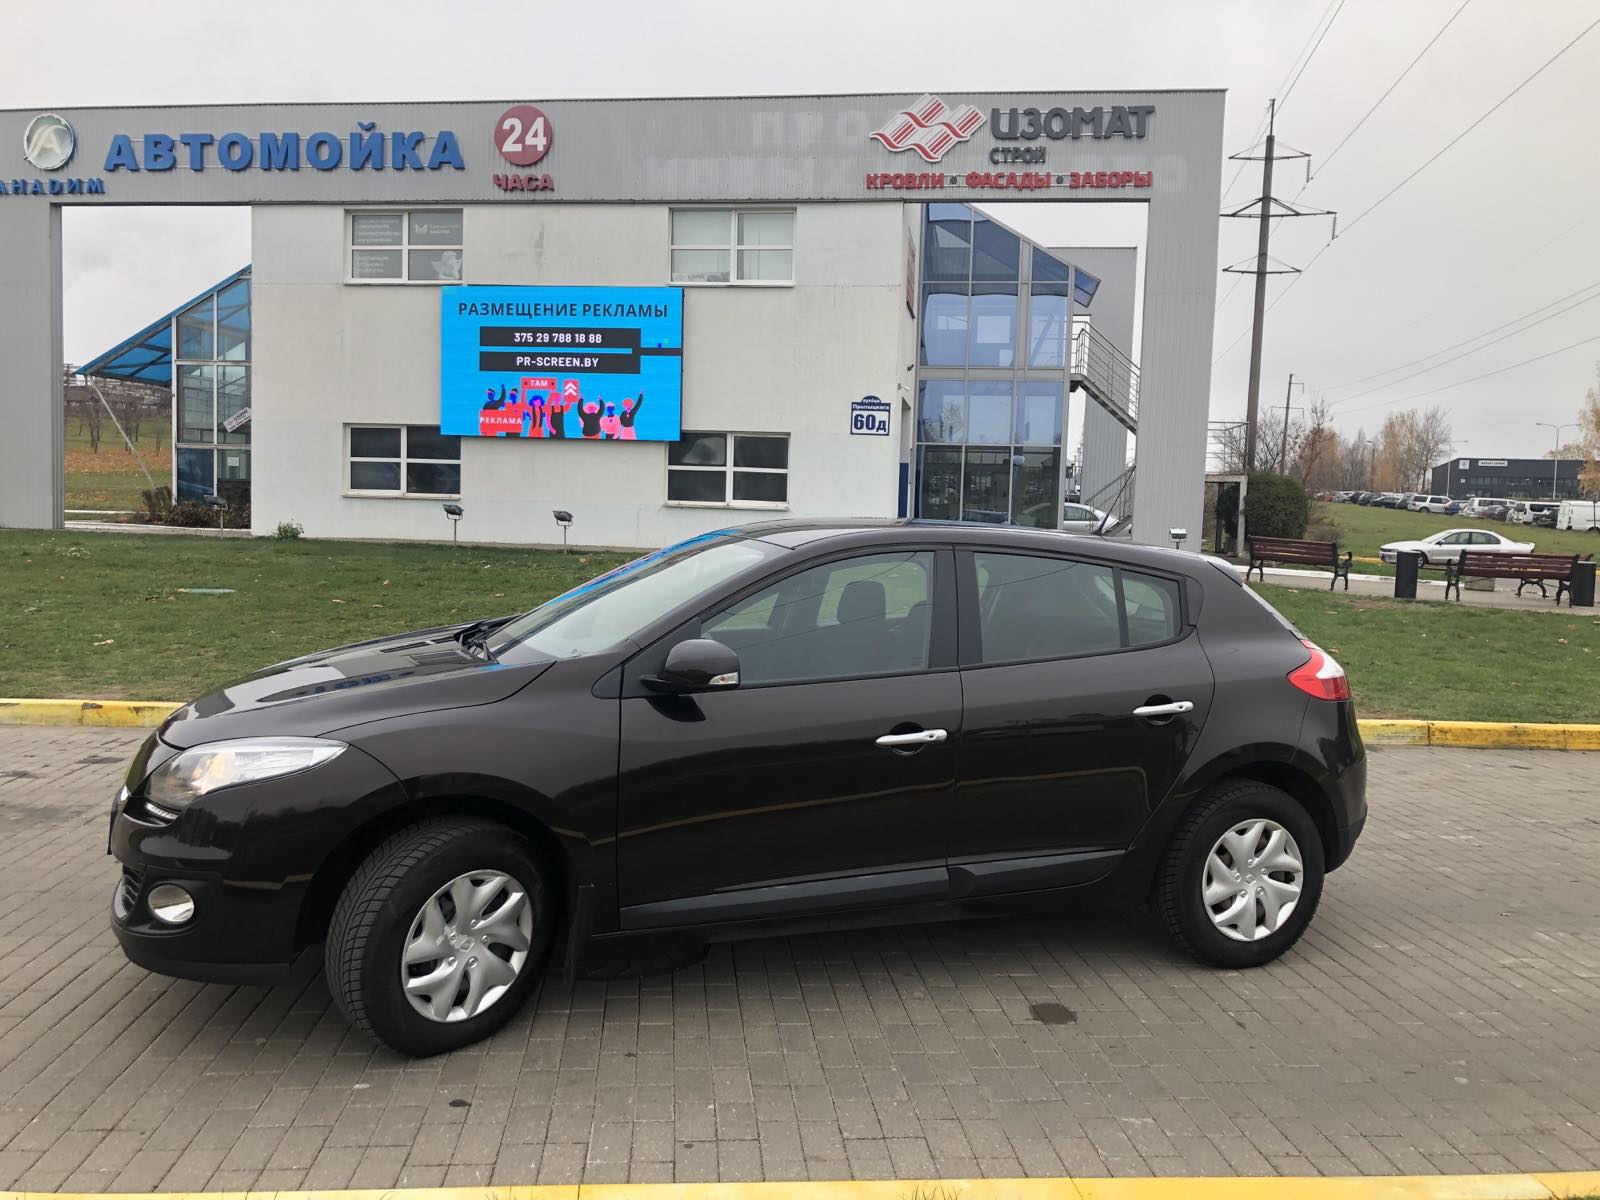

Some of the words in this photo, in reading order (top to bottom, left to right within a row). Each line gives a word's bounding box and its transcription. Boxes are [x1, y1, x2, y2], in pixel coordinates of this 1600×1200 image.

[502, 116, 547, 152] 24
[103, 121, 465, 172] АВТОМОЙКА
[990, 146, 1047, 164] СТРОЙ
[493, 174, 554, 191] ЧАСА
[866, 172, 945, 189] КРОВЛИ
[965, 171, 1051, 191] ФАСАДЫ
[1069, 171, 1152, 189] ЗАБОРЫ
[458, 302, 577, 319] РАЗМЕЩЕНИЕ
[582, 303, 668, 318] РЕКЛАМЫ
[514, 332, 534, 343] 375
[536, 333, 550, 343] 29
[552, 333, 572, 344] 788
[575, 334, 586, 344] 18
[588, 333, 602, 344] 88
[516, 356, 599, 368] PR-SCREEN.BY
[529, 379, 549, 388] ТАМ
[480, 416, 522, 425] РЕКЛАМА
